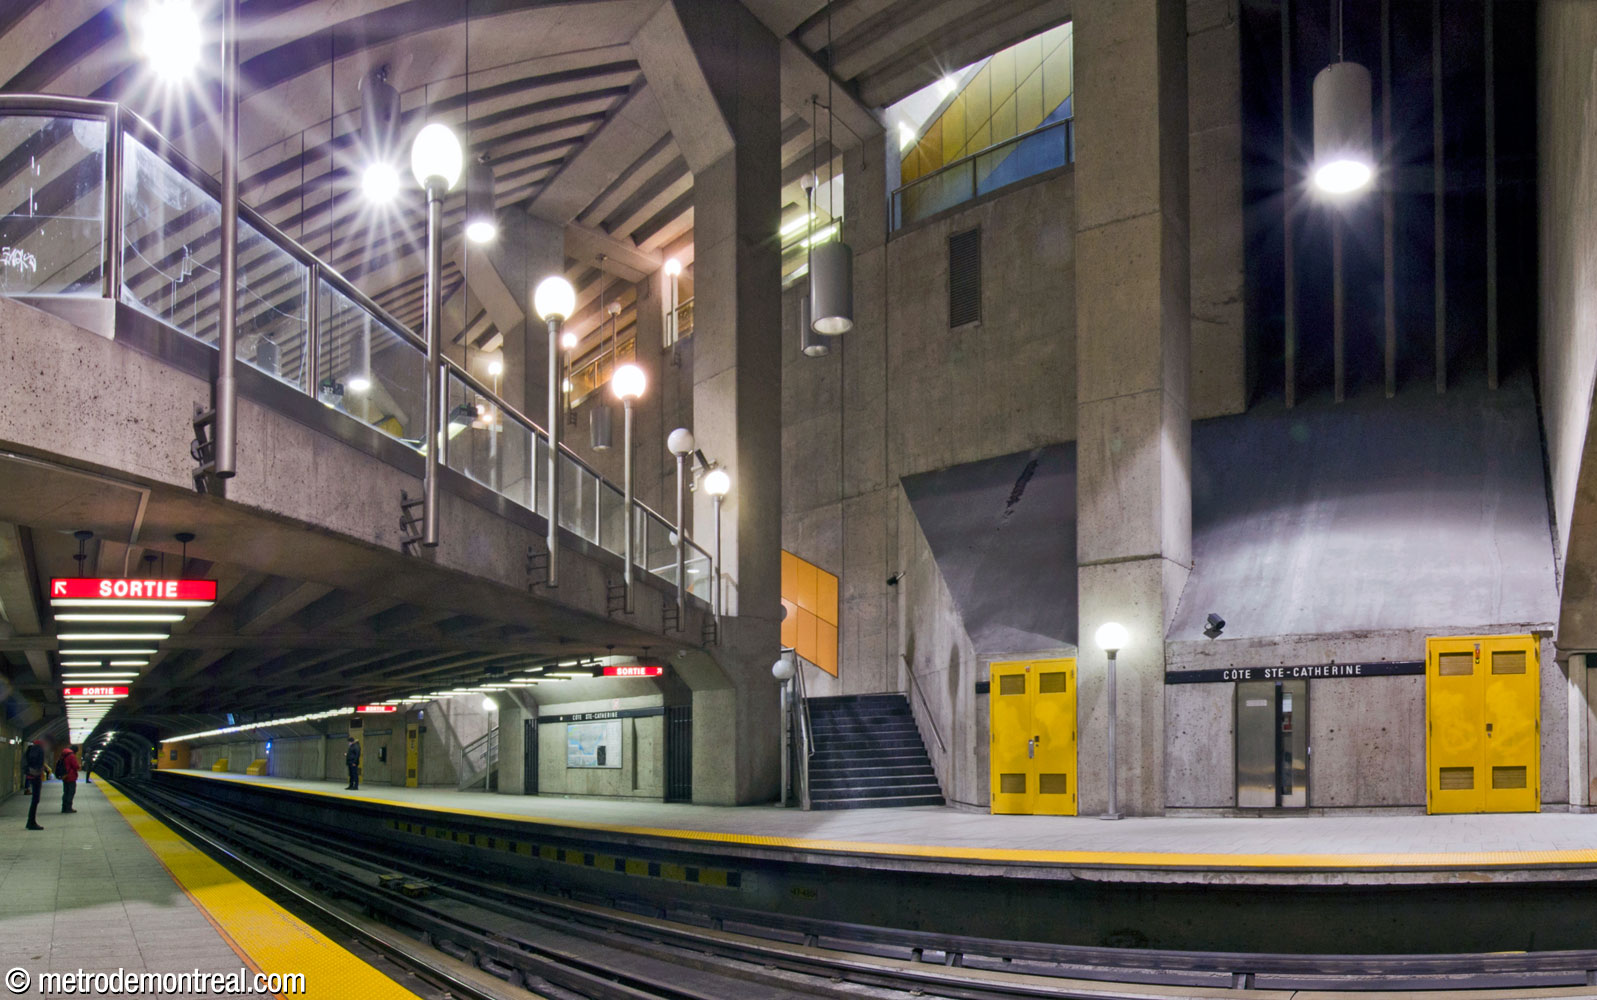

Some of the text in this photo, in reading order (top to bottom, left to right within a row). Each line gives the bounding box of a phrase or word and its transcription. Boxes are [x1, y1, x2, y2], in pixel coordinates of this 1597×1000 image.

[100, 580, 178, 597] SORTIE
[616, 667, 646, 675] SORTIE
[1223, 665, 1361, 680] CÔTE STE-CATHERINE
[82, 687, 114, 695] SORTIE
[585, 711, 618, 720] STE-CATHERINE
